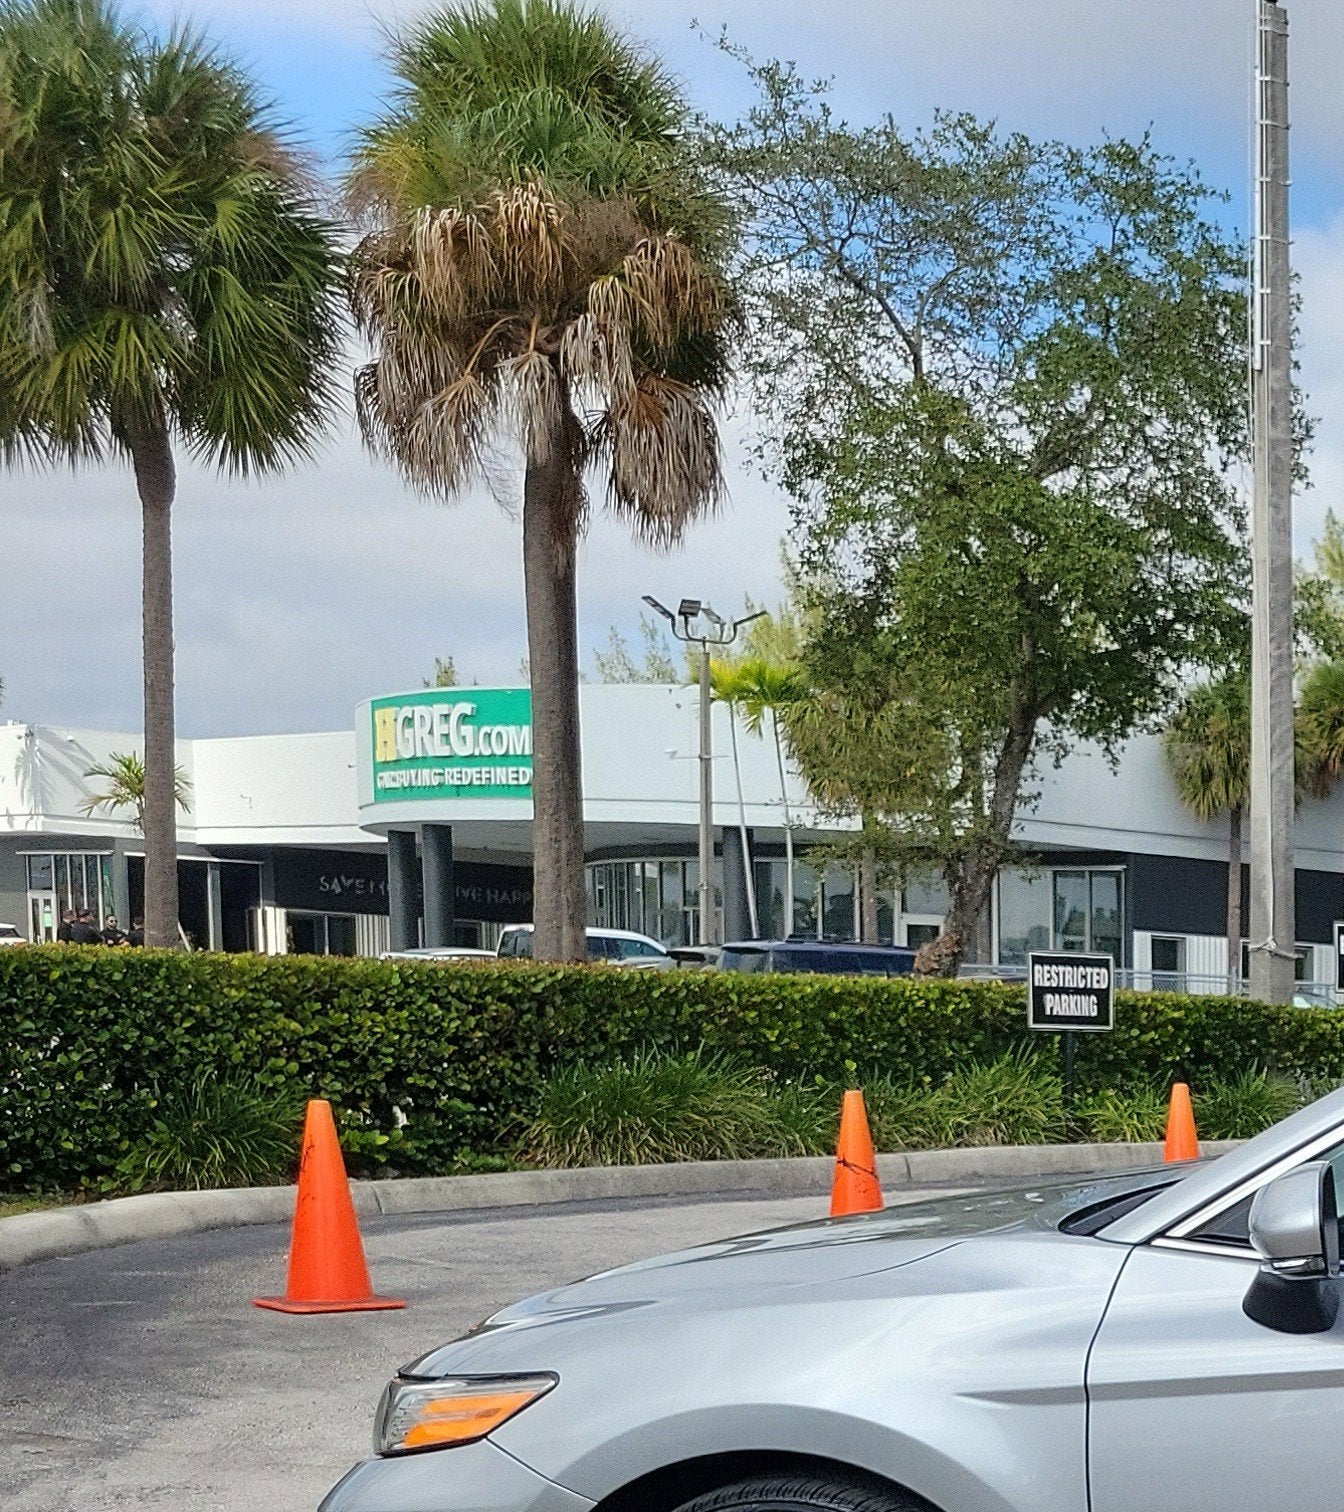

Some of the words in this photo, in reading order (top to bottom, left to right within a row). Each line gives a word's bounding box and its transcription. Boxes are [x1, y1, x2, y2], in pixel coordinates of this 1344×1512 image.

[444, 766, 531, 785] REDEFINED
[1033, 963, 1109, 990] RESTRICTED
[1044, 993, 1098, 1017] PARKING
